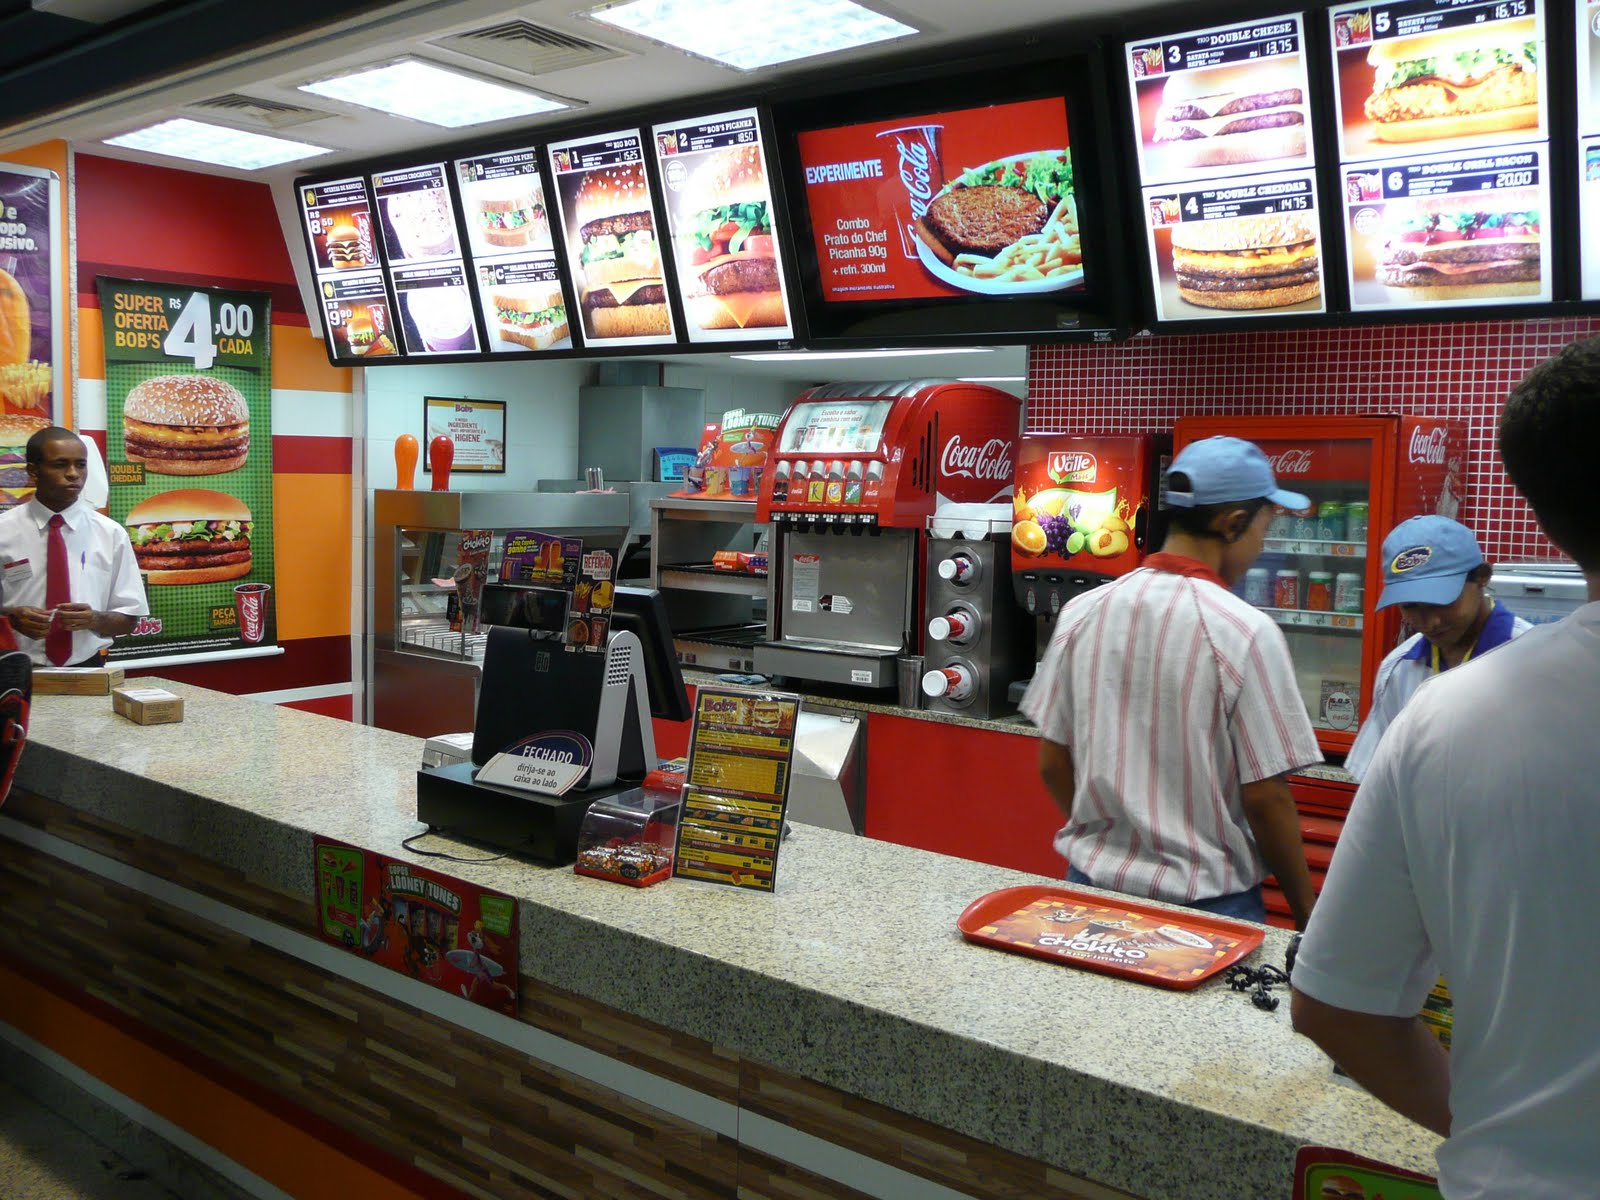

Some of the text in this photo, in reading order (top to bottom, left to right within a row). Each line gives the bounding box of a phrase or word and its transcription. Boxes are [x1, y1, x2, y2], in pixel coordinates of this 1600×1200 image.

[1375, 12, 1391, 32] 5
[1210, 30, 1251, 45] DOUBLE
[1252, 22, 1292, 38] CHEESE
[1168, 46, 1181, 63] 3
[680, 133, 688, 147] 2
[572, 151, 579, 163] 1
[476, 164, 484, 176] B
[806, 159, 883, 184] EXPERIMENTE
[1421, 162, 1462, 175] DOUBLE
[1388, 171, 1403, 191] 6
[1216, 186, 1256, 200] DOUBLE
[1257, 181, 1307, 196] CHEDDAR
[7, 206, 17, 220] e
[1185, 197, 1198, 214] 4
[0, 222, 27, 237] opo
[836, 217, 870, 231] Combo
[824, 229, 887, 246] Prato do Chef
[829, 245, 887, 260] Picanha 90g
[496, 268, 504, 280] C
[840, 264, 859, 275] refri.
[860, 262, 886, 274] 300ml
[114, 293, 164, 314] SUPER
[169, 297, 182, 310] R$
[114, 313, 169, 332] OFERTA
[115, 330, 161, 351] BOB'S
[218, 336, 253, 355] CADA
[447, 421, 479, 429] INGREDIENTE
[723, 415, 756, 431] LOONEY
[757, 415, 780, 428] TUNE
[455, 433, 481, 442] HIGIENE
[110, 464, 143, 474] DOUBLE
[1053, 454, 1091, 473] Valle
[110, 474, 143, 482] CHEDDAR
[845, 484, 860, 501] Sprite
[212, 607, 236, 620] PEÇA
[212, 618, 236, 627] TAMBÉM
[522, 745, 573, 764] FECHADO
[517, 763, 546, 775] dirija-se
[514, 774, 531, 783] caixa
[542, 778, 557, 788] lado
[390, 875, 459, 911] LOONEY TUNES
[1057, 949, 1138, 965] Experimente.
